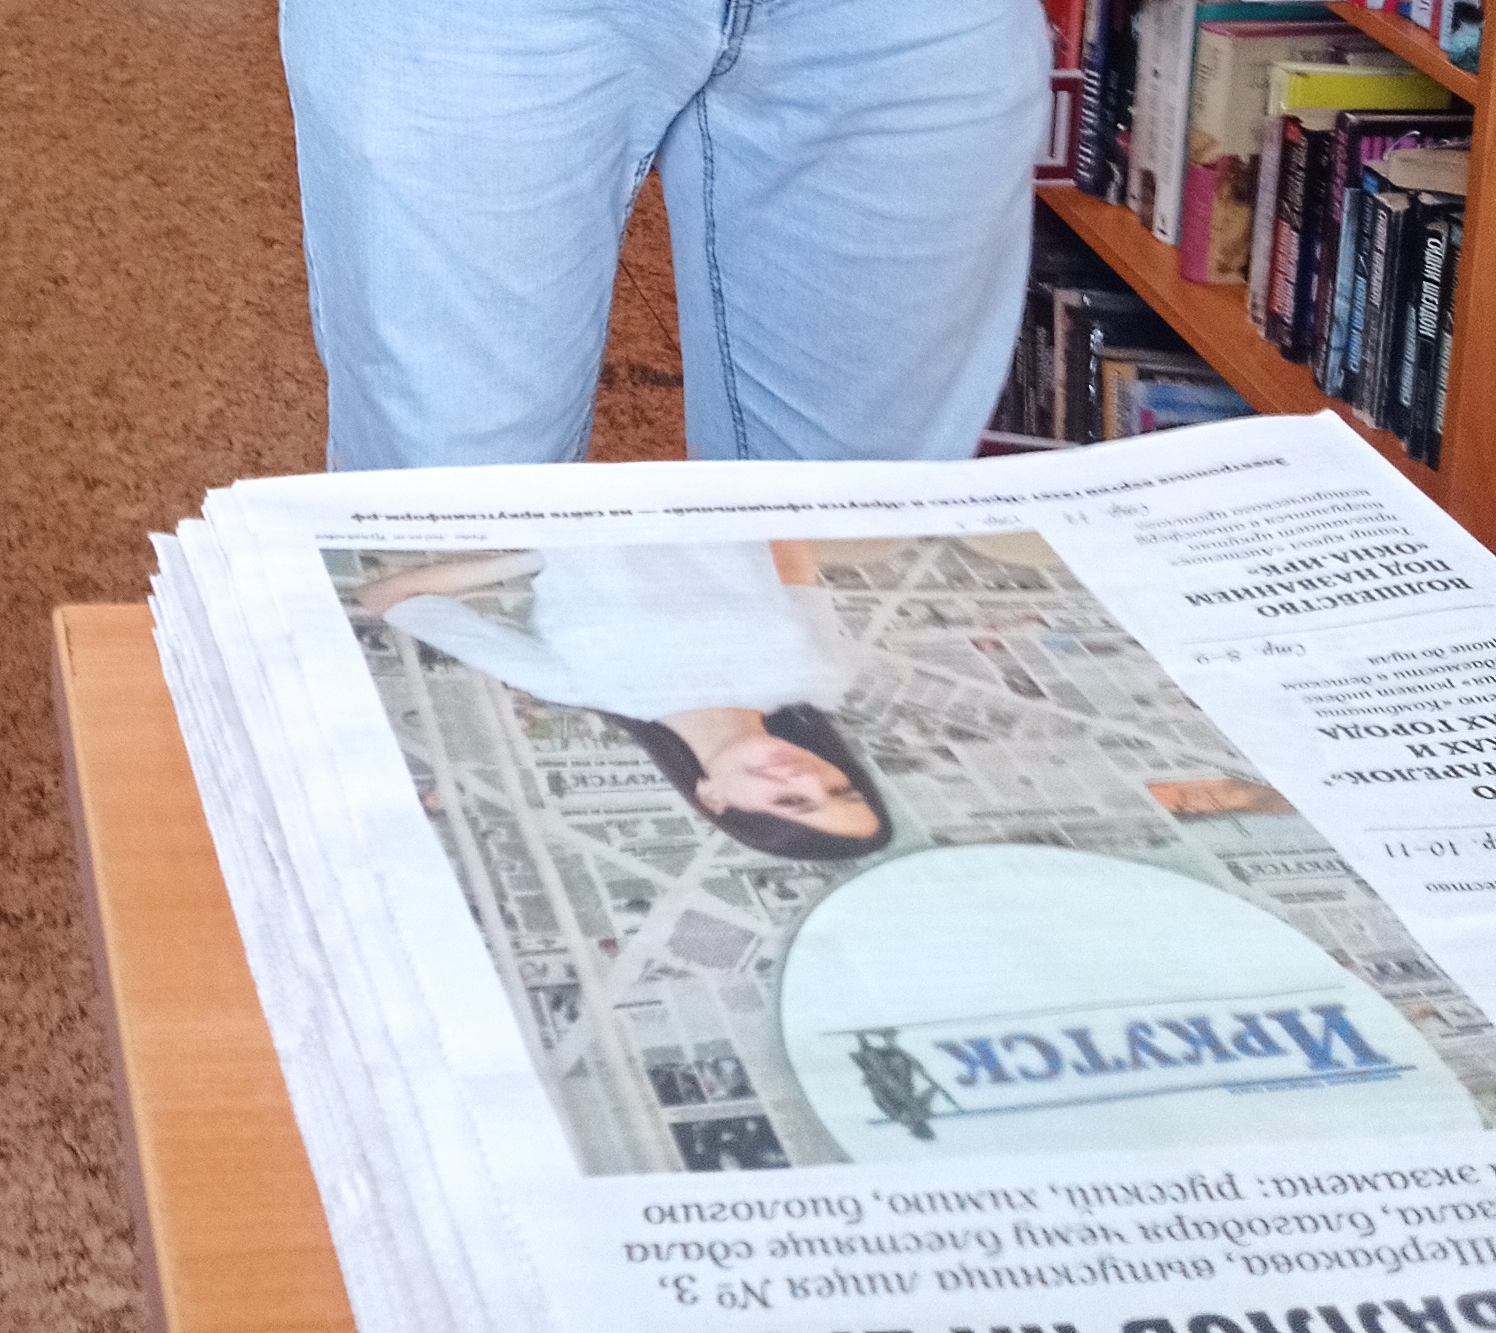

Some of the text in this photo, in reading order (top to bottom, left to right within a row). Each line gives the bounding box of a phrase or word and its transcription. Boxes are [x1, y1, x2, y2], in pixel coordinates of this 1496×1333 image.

[1418, 238, 1447, 339] СИДНИ ШЕЛДОН
[1184, 558, 1452, 607] ПОД НАЗВАНИЕМ
[1257, 576, 1472, 618] ВОЛШЕБСТВО
[1367, 650, 1418, 666] нуля
[1421, 648, 1445, 660] до
[1376, 678, 1456, 698] роняет
[1317, 719, 1457, 741] ГОРОДА
[1405, 743, 1438, 759] И
[642, 1165, 1478, 1226] экзамена: русский, химию, биологию
[768, 1231, 1002, 1260] блестяще
[1012, 1221, 1130, 1251] чему
[1138, 1211, 1375, 1247] благодаря
[623, 1238, 754, 1271] сдала
[785, 1266, 919, 1302] лицея
[934, 1254, 1215, 1292] выпускница
[657, 1274, 699, 1307] 3,
[716, 1278, 774, 1311] №
